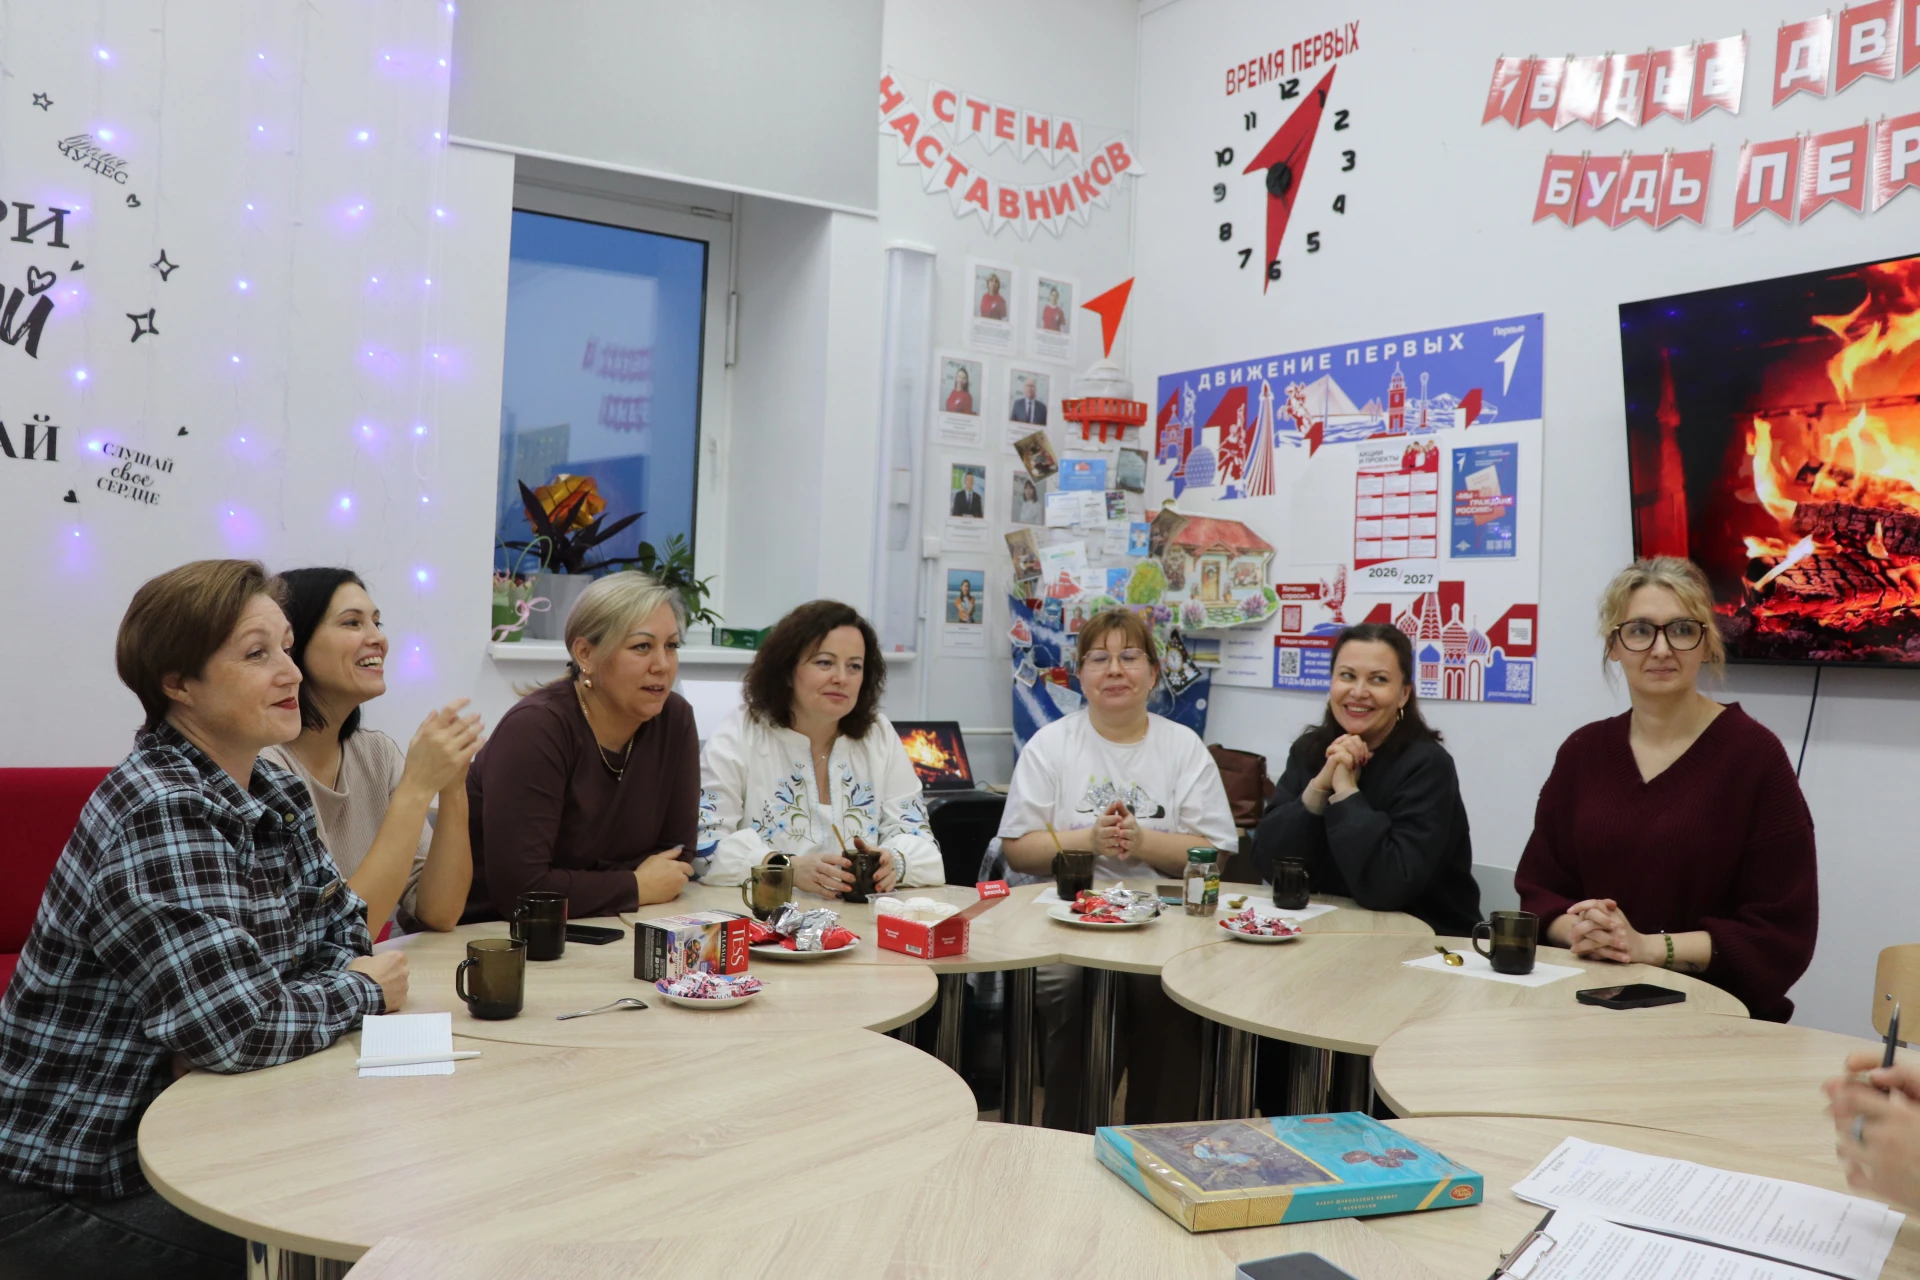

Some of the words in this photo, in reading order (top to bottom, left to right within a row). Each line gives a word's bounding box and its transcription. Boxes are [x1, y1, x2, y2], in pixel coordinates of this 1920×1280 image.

[1226, 49, 1285, 96] ВРЕМЯ
[1291, 20, 1360, 73] ПЕРВЫХ
[1530, 65, 1682, 112] БДЬ
[1780, 4, 1920, 89] ДВ
[1279, 78, 1299, 100] 12
[932, 90, 1080, 153] СТЕНА
[1244, 112, 1257, 131] 11
[1334, 110, 1350, 131] 2
[880, 75, 1131, 220] НАСТАВНИКОВ
[1215, 147, 1234, 167] 10
[58, 140, 128, 185] ЧУДЕС
[1341, 150, 1356, 172] 3
[1213, 183, 1226, 203] 9
[1544, 166, 1701, 213] БУДЬ
[1332, 194, 1346, 214] 4
[0, 200, 71, 249] И
[1219, 222, 1232, 241] 8
[1306, 231, 1320, 253] 5
[1238, 248, 1252, 269] 7
[1267, 260, 1282, 281] 6
[1198, 353, 1332, 392] ДВИЖЕНИЕ
[1346, 332, 1465, 366] ПЕРВЫХ
[103, 442, 173, 473] СЛУШАЙ
[1358, 449, 1384, 458] АКЦИИ
[1366, 455, 1400, 464] ПРОЕКТЫ
[97, 477, 160, 505] СЕРДЦЕ
[730, 925, 746, 967] TESS
